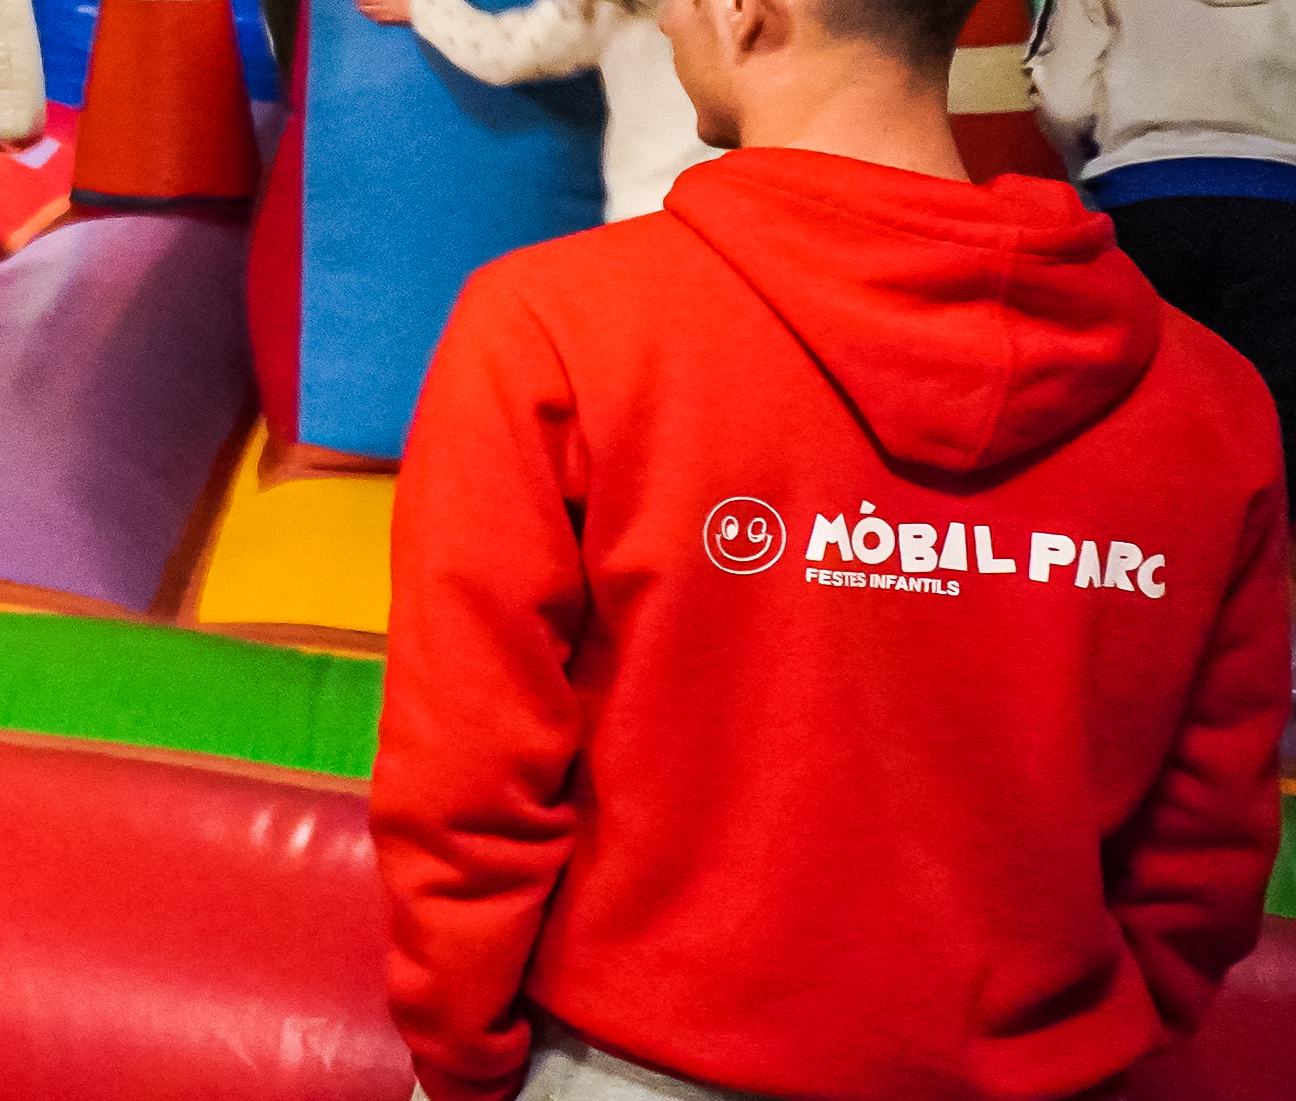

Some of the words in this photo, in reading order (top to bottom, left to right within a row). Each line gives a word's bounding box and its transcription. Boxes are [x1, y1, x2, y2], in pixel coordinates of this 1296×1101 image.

[805, 567, 867, 588] FESTES
[869, 573, 961, 598] INFANTILS
[1028, 531, 1167, 599] PARC
